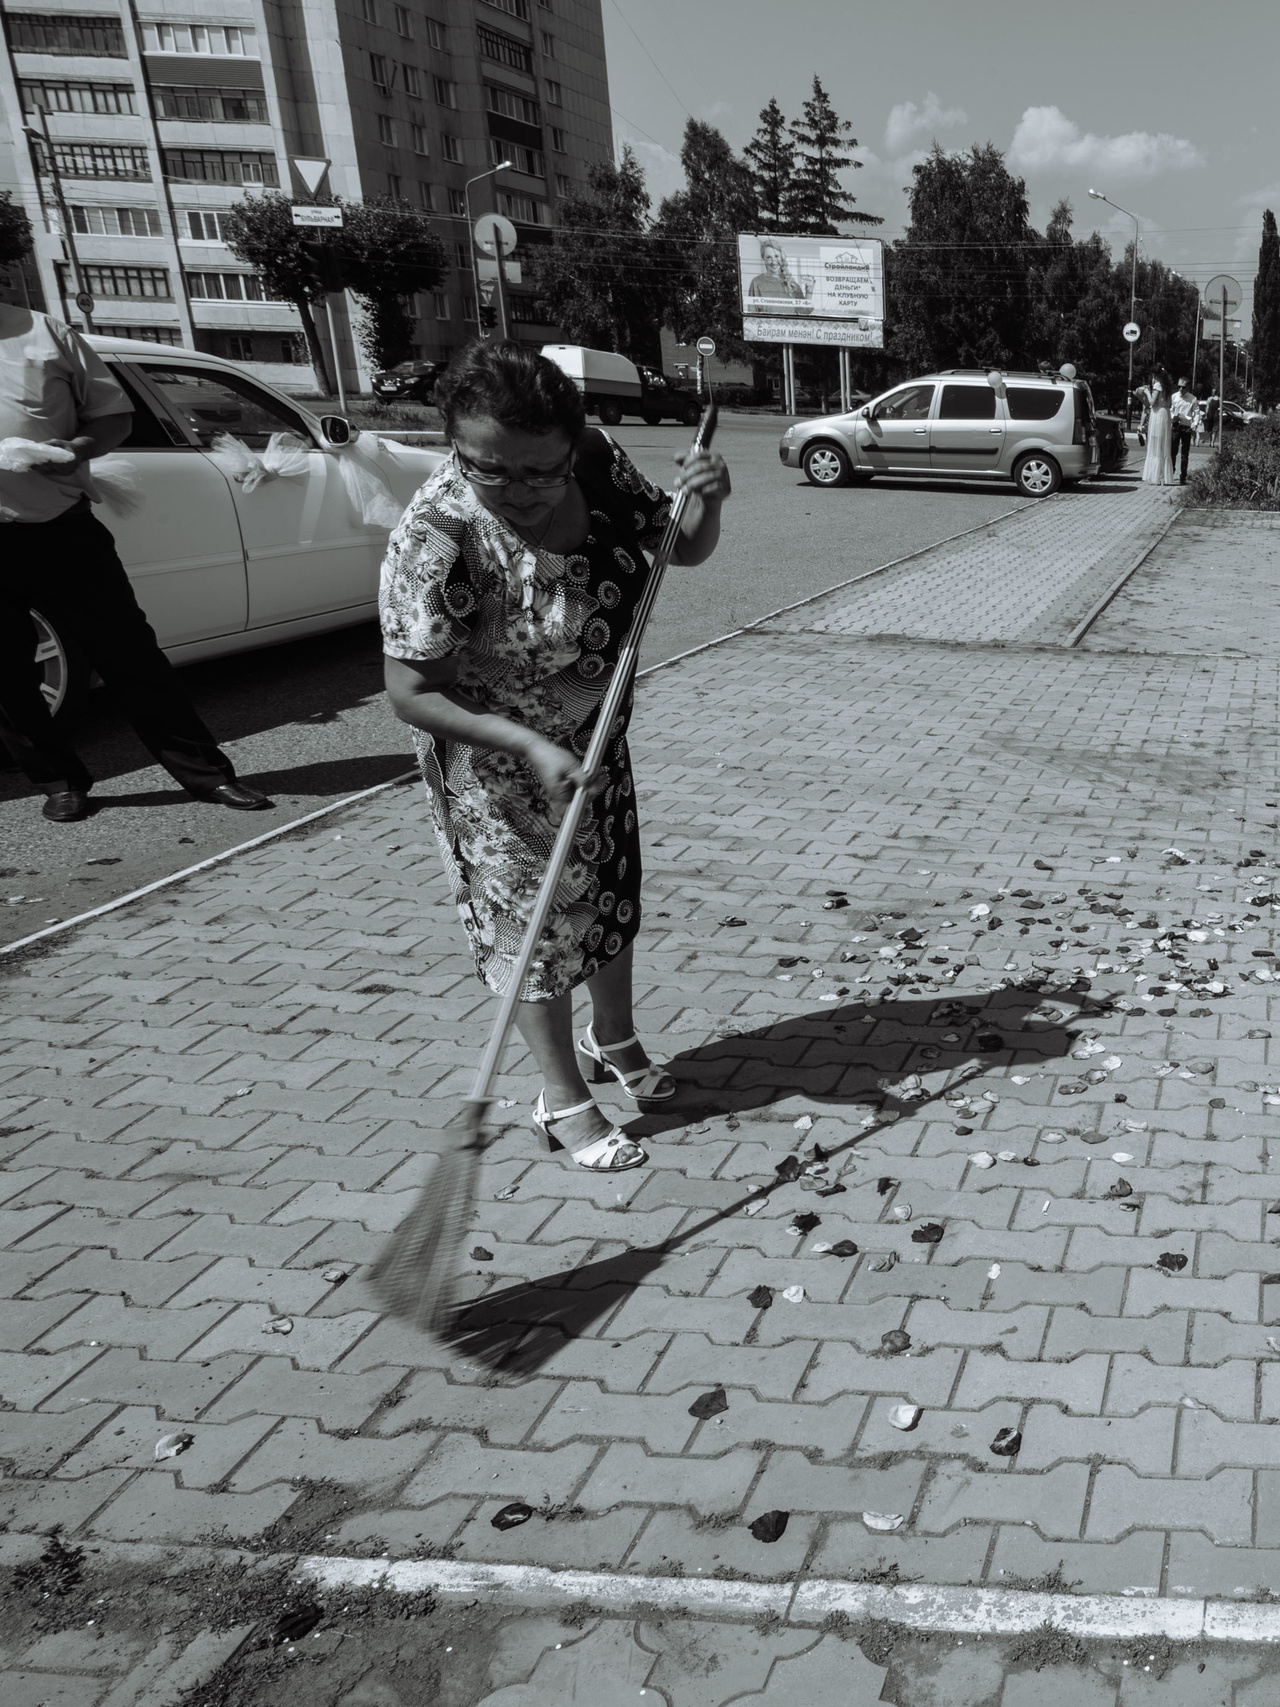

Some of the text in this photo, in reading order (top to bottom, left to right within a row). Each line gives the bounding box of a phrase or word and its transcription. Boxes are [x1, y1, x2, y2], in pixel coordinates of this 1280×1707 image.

[826, 276, 869, 284] ВОЗВРАЩАЕМ
[80, 298, 91, 307] 40
[757, 325, 786, 339] Байрам
[816, 329, 822, 340] С
[823, 331, 873, 344] праздником!
